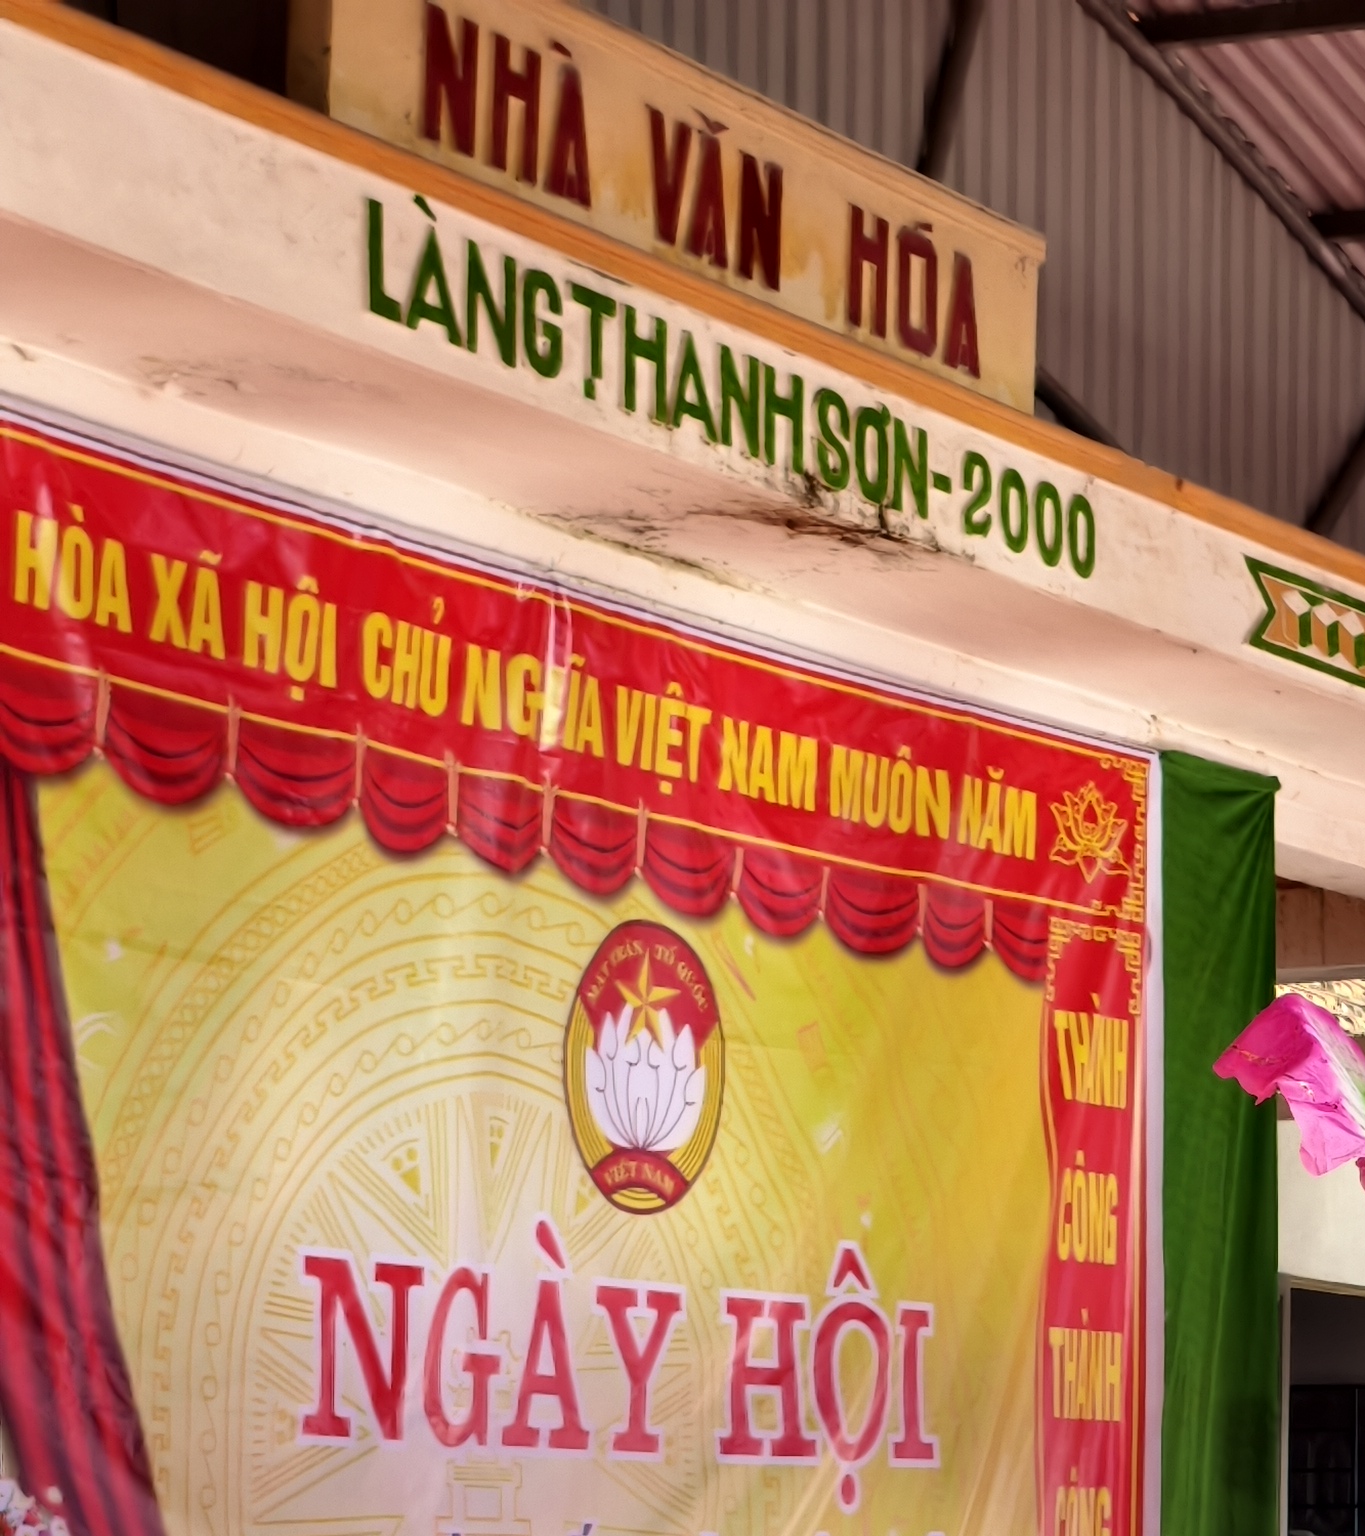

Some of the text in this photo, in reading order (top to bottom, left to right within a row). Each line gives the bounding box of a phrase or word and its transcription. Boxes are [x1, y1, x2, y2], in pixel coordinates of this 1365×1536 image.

[424, 1, 981, 379] NHÀ VĂN HÓA
[367, 195, 563, 380] LÀNG
[569, 280, 803, 475] THANH
[14, 504, 1037, 860] HÒA XÃ HỘI CHỦ NGĨA VIỆT NAM MUÔN NĂM
[1054, 992, 1129, 1109] THÀNH
[1056, 1150, 1118, 1265] CÔNG
[303, 1220, 934, 1507] NGÀY HỘI
[1049, 1308, 1122, 1422] THÀNH
